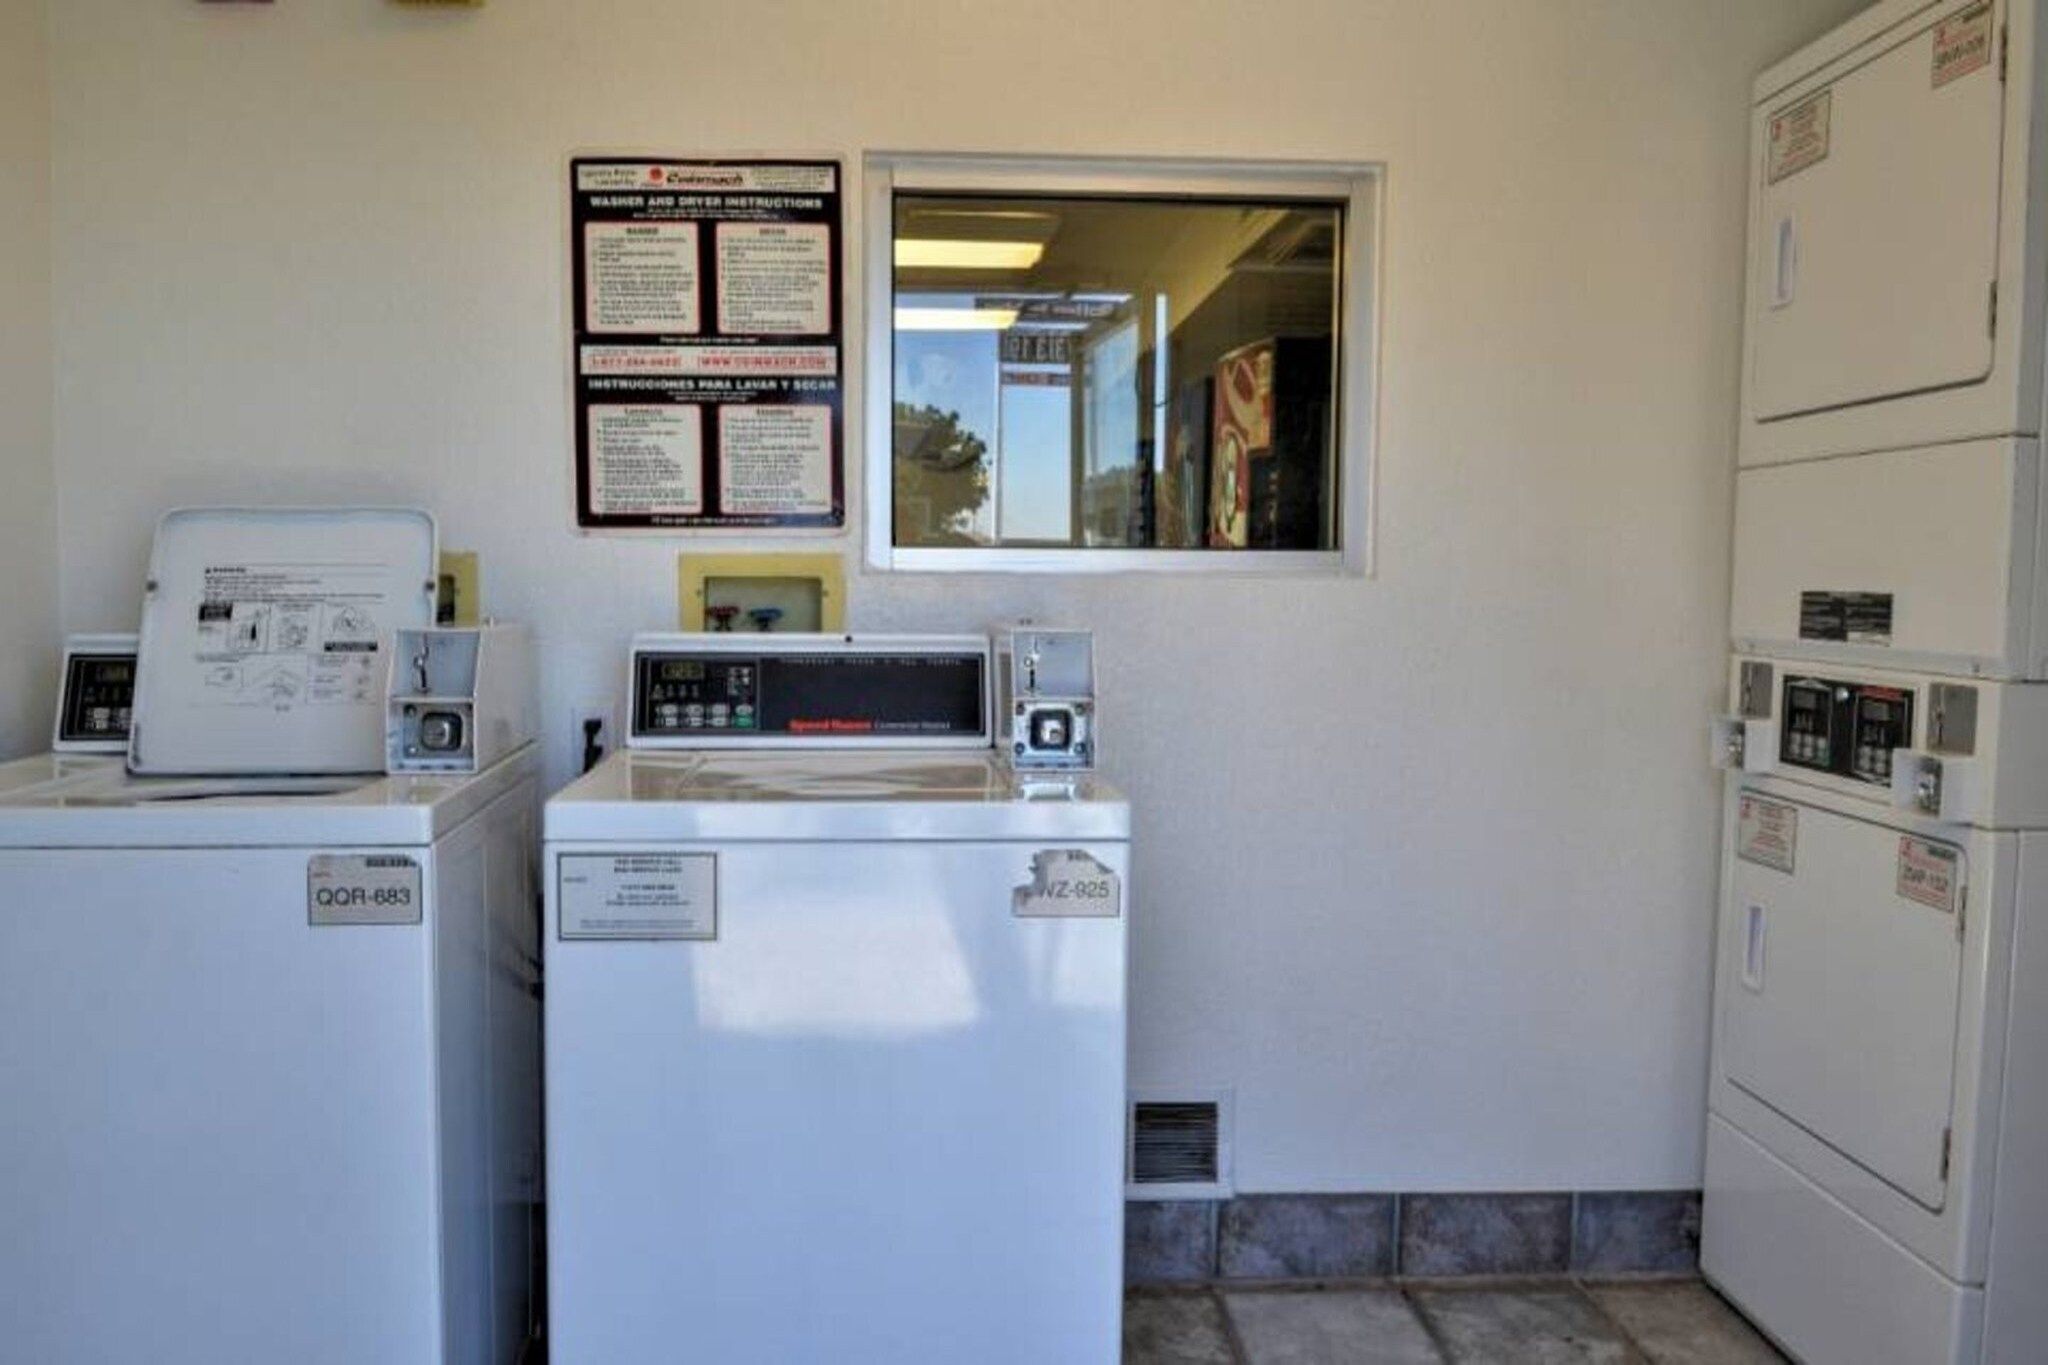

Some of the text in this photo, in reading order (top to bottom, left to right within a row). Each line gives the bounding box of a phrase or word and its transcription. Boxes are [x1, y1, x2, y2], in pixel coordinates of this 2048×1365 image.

[590, 196, 823, 210] WASHER AND DRYER INSTRUCTIONS
[588, 379, 837, 391] INSTRUCCIONES PARA LAVAR Y SECAR
